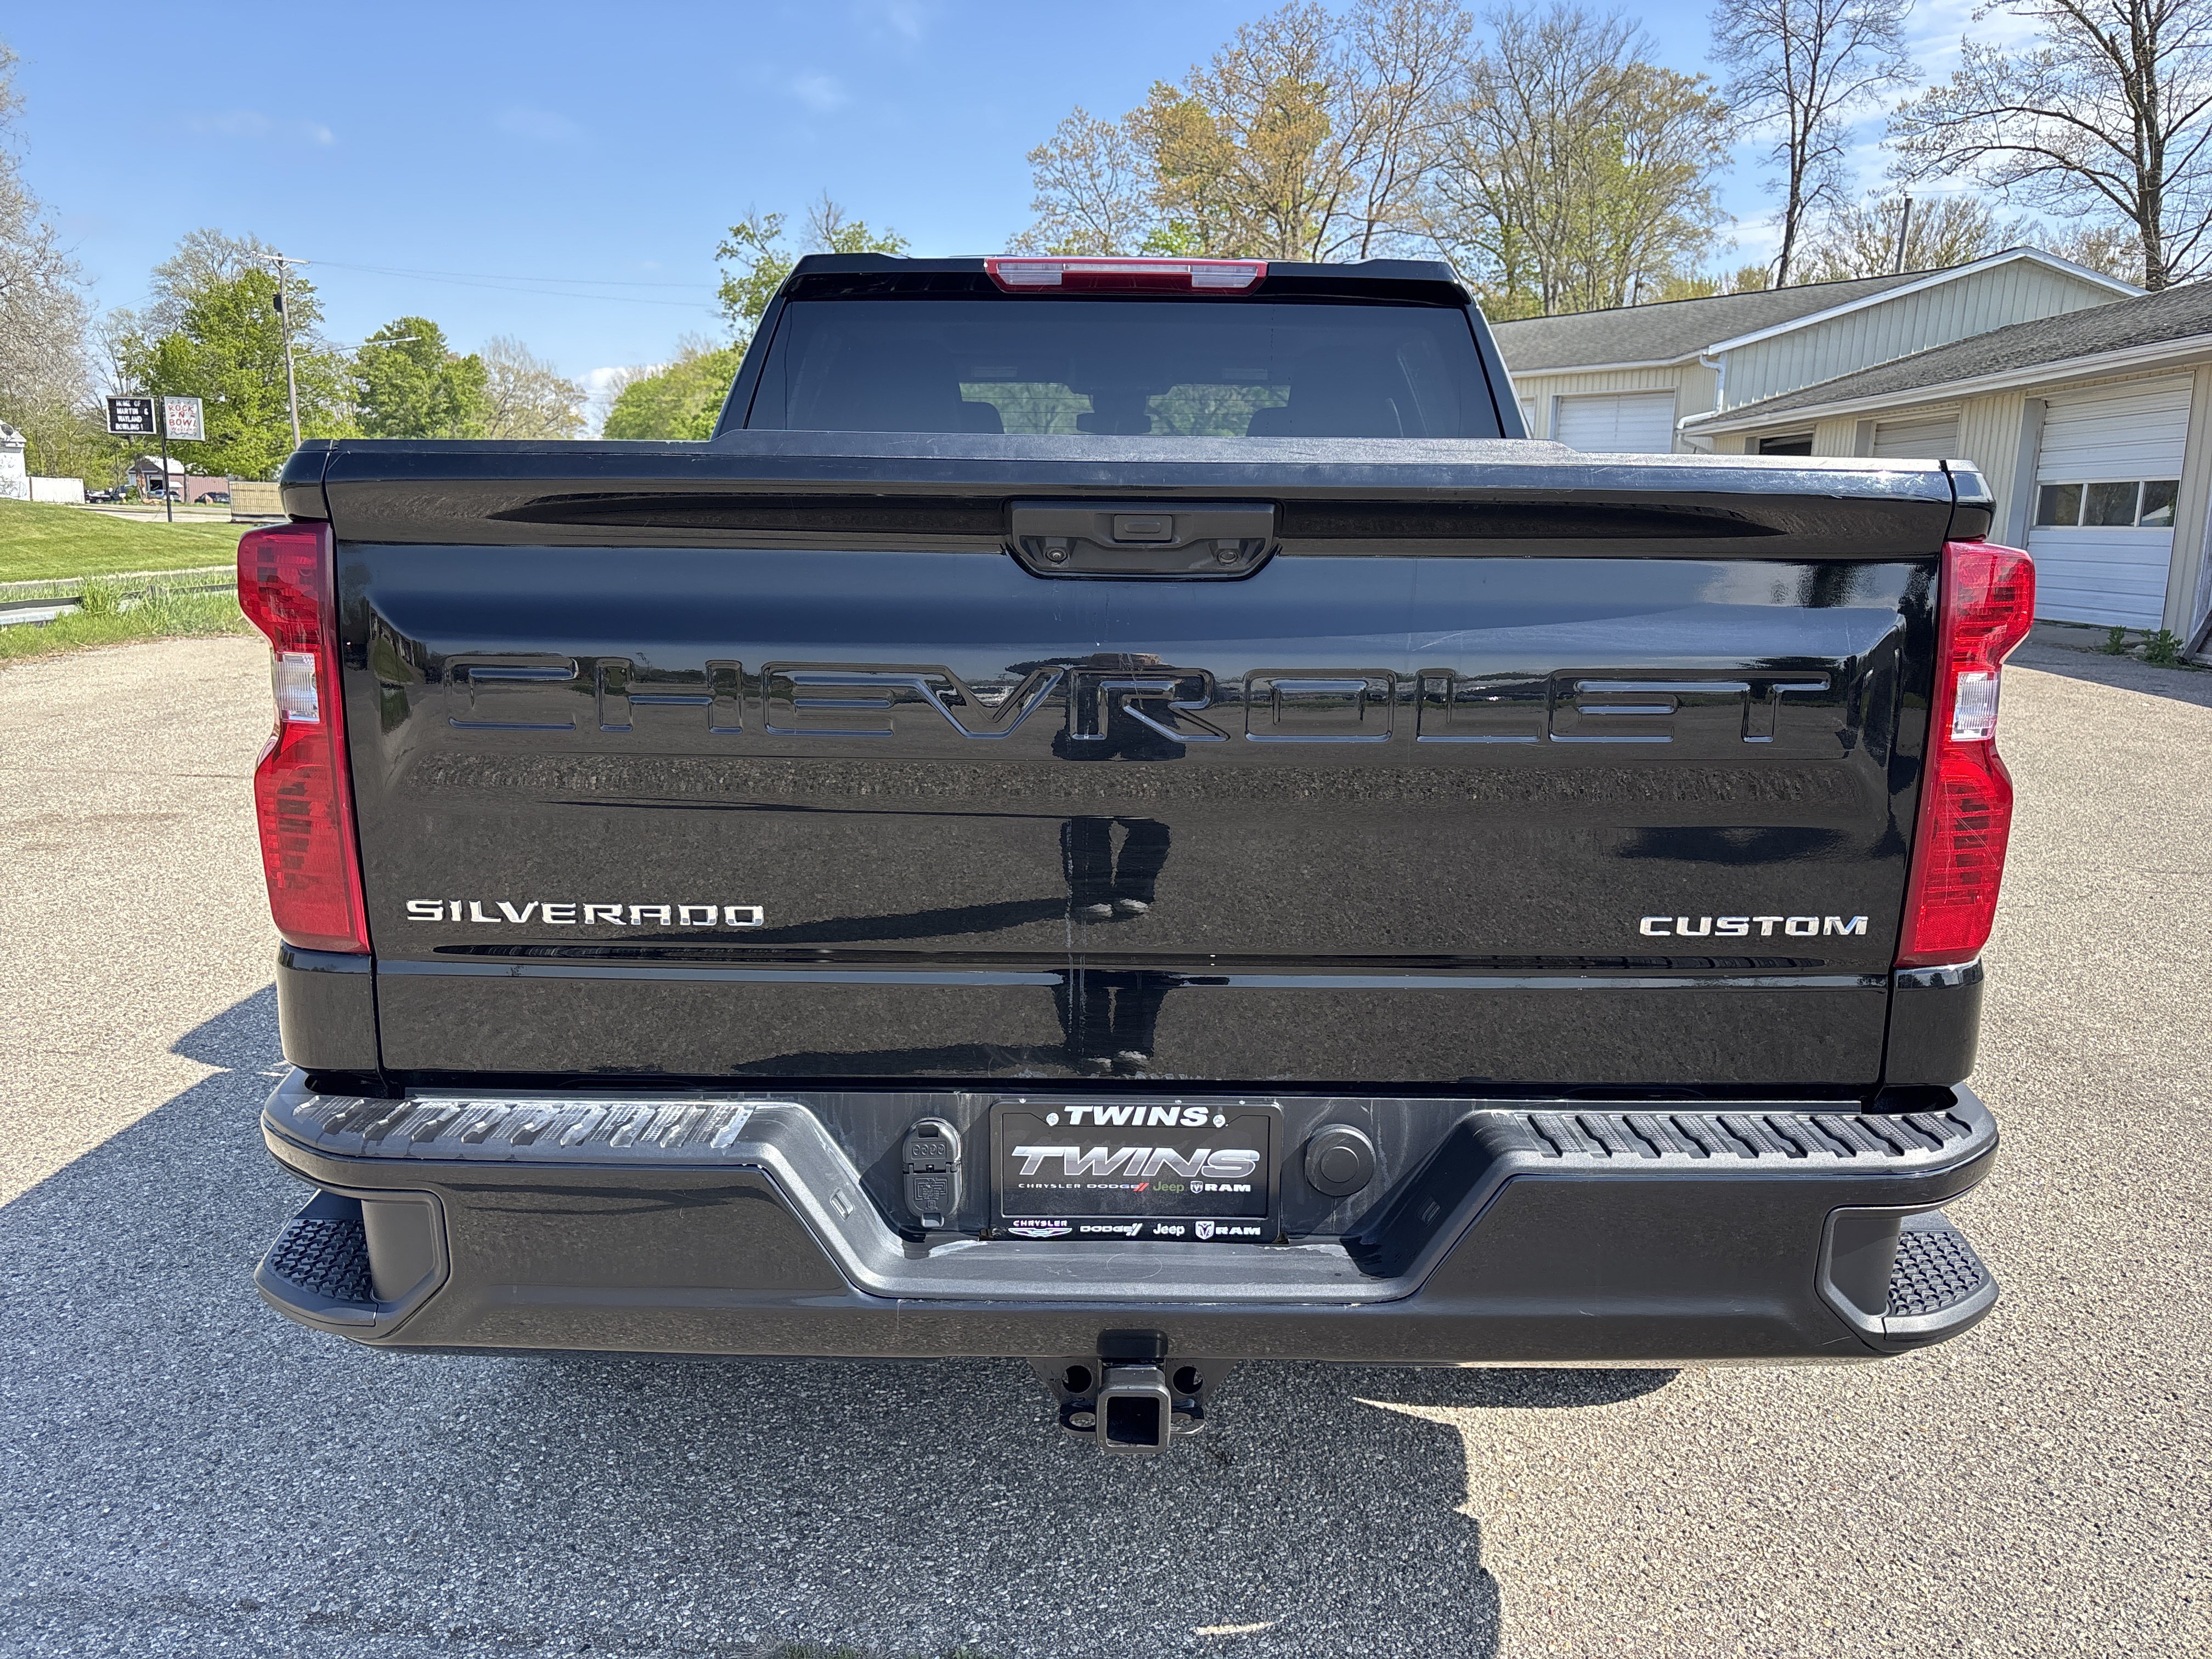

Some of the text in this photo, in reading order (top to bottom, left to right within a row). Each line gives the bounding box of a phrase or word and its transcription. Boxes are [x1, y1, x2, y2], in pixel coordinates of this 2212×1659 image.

[169, 419, 198, 427] BOWL
[443, 654, 1831, 743] CHEVROLET
[405, 898, 765, 927] SILVERADO
[1639, 916, 1869, 936] CUSTOM
[1064, 1105, 1209, 1127] TWINS
[1011, 1145, 1261, 1178] TWINS
[1153, 1181, 1184, 1193] Jeep
[1204, 1183, 1251, 1192] RAM
[1080, 1225, 1135, 1233] DODGE
[1153, 1223, 1185, 1235] Jeep
[1215, 1226, 1261, 1236] RAM
